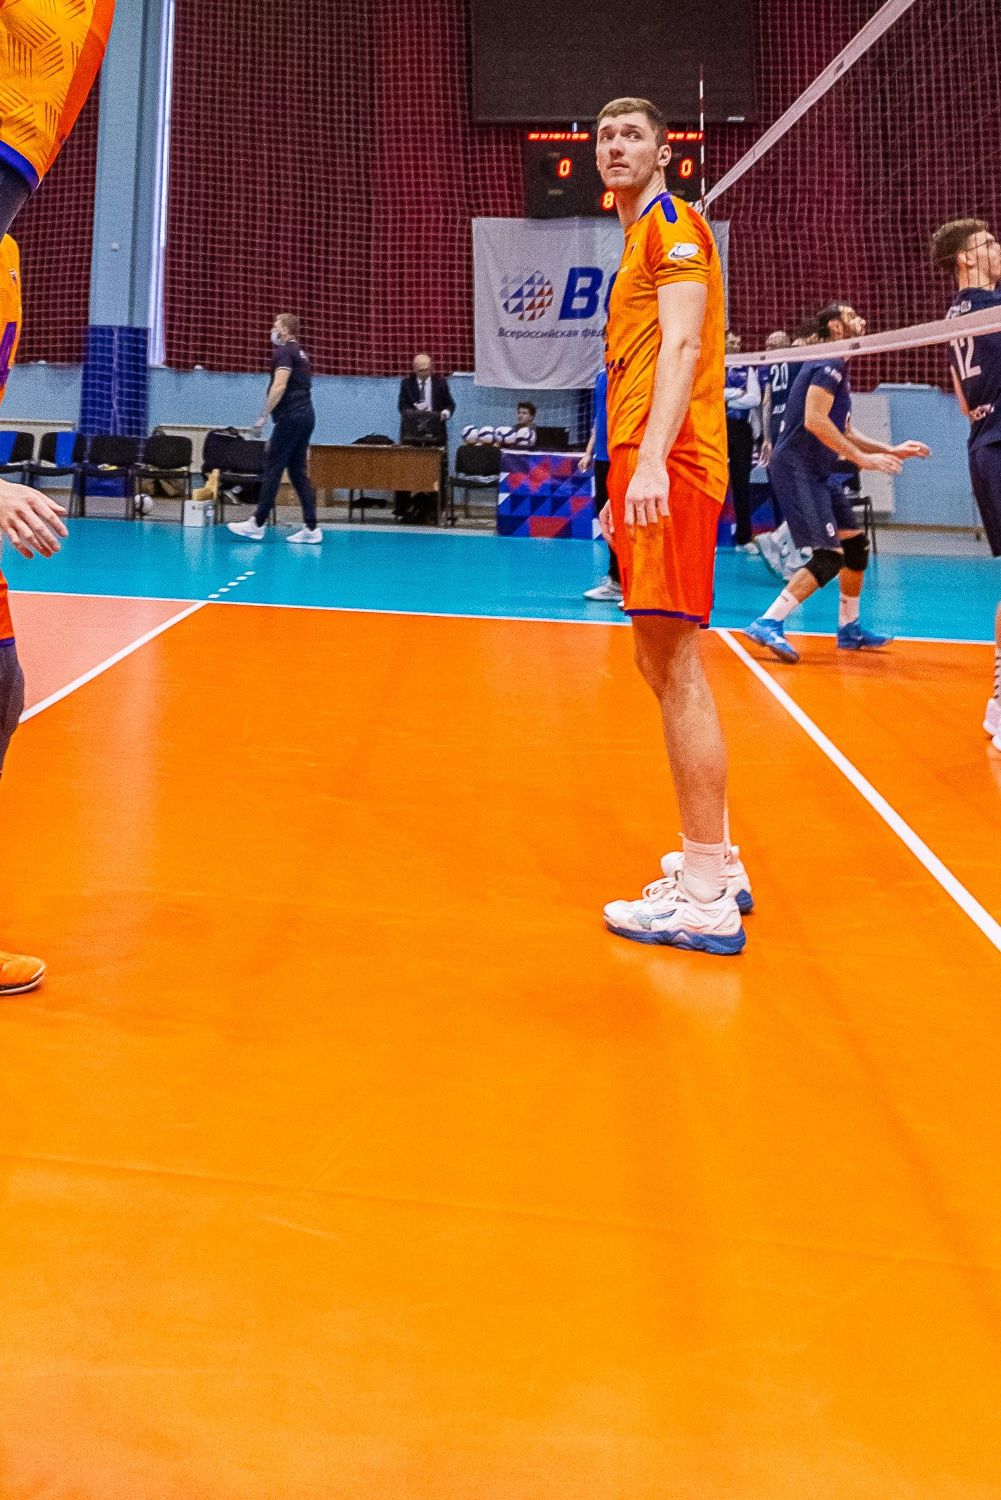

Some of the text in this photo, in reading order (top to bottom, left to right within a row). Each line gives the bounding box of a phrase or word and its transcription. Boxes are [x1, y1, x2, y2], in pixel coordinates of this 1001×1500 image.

[559, 159, 571, 177] 0
[680, 159, 693, 177] 0
[498, 326, 579, 340] Всероссийская
[950, 335, 982, 381] 12
[770, 362, 788, 392] 20
